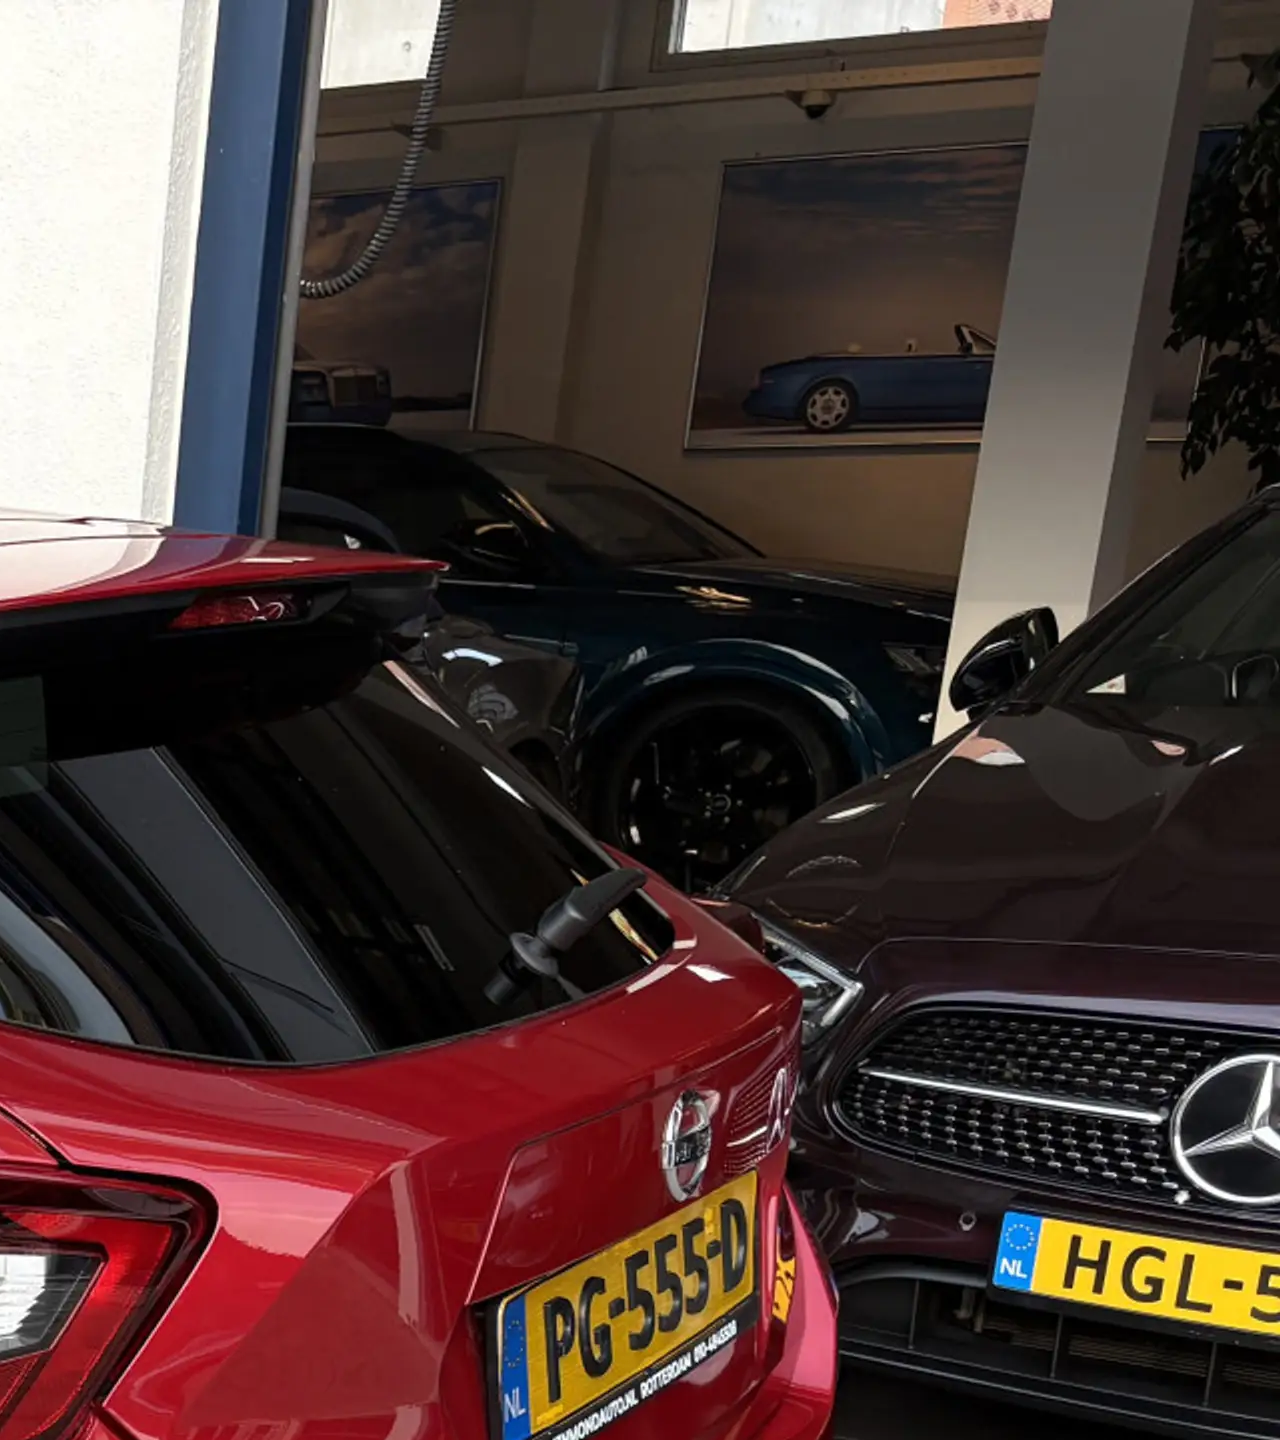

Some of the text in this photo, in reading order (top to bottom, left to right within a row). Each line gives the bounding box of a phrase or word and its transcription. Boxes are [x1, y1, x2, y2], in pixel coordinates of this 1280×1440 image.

[999, 1257, 1028, 1278] NL
[543, 1199, 747, 1403] PG-555-D
[640, 1352, 692, 1399] ROTTERDAM
[504, 1388, 526, 1424] NL
